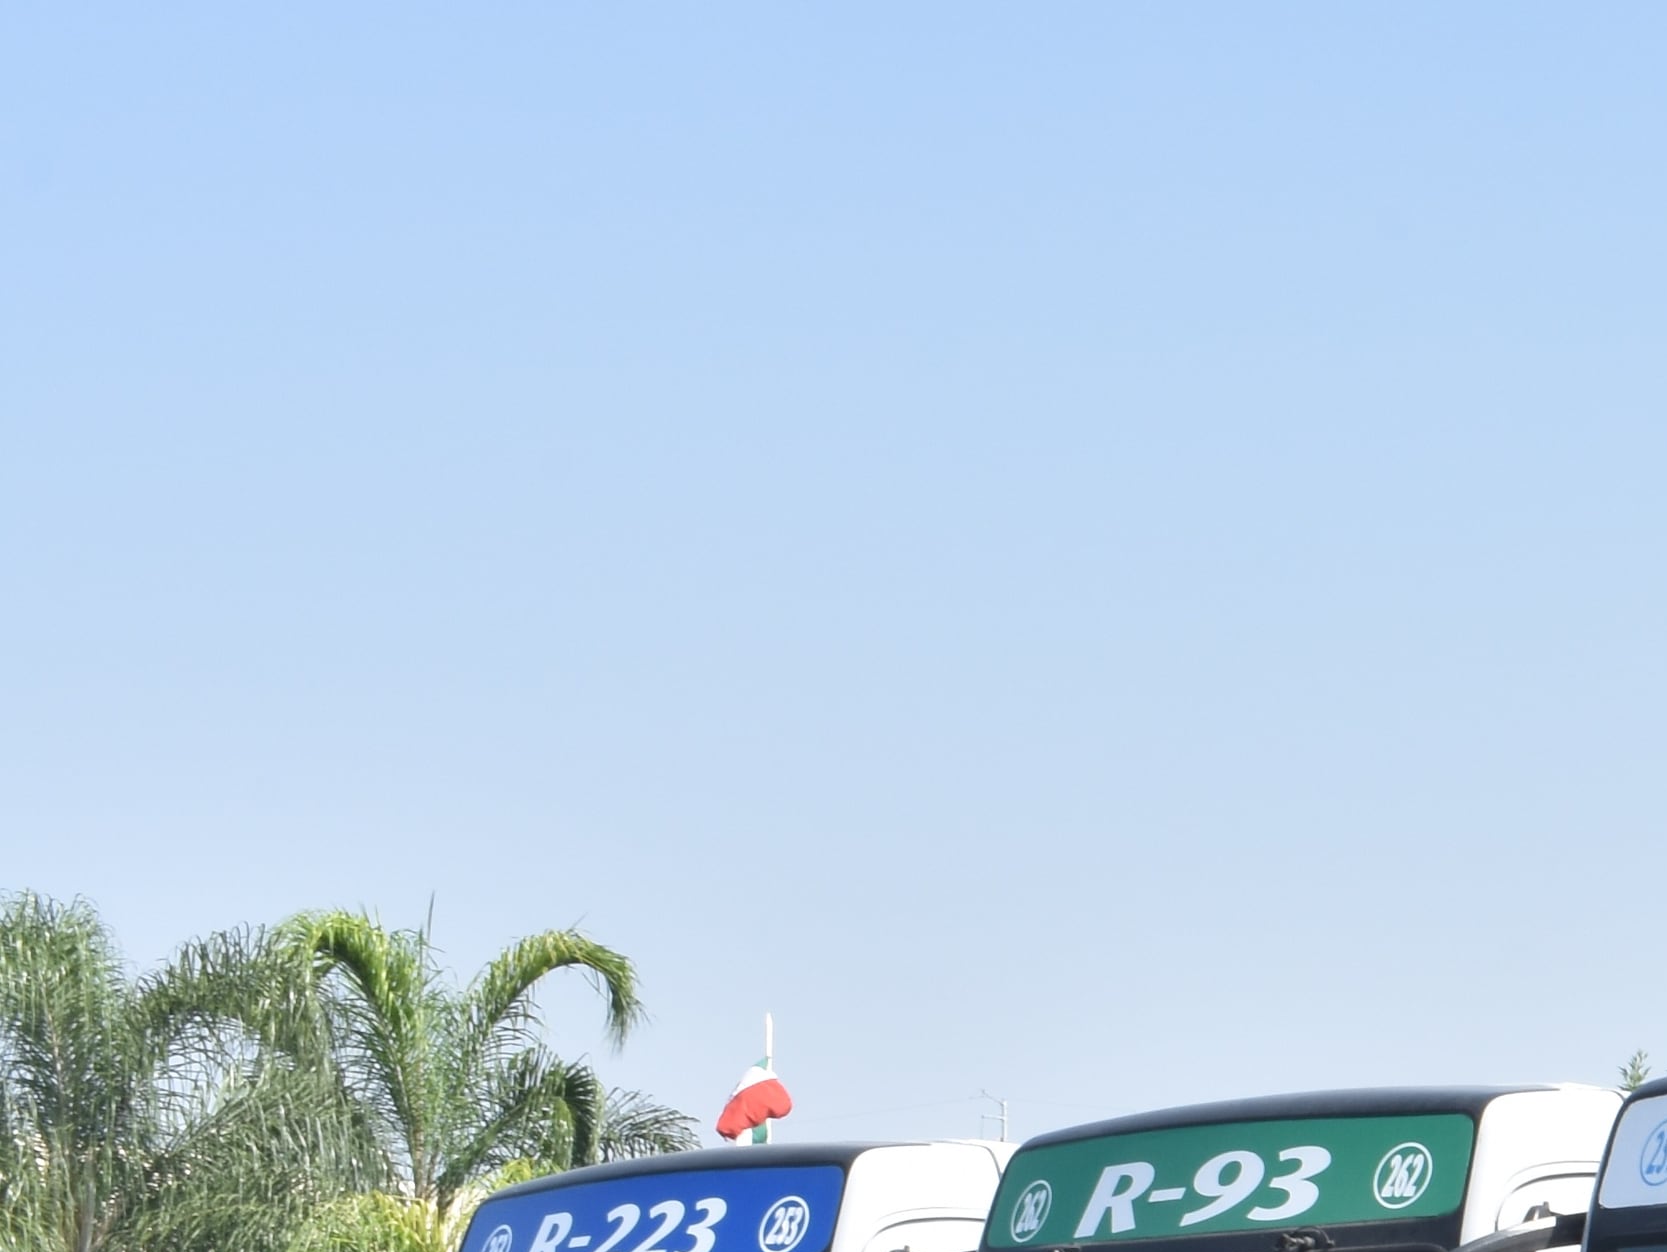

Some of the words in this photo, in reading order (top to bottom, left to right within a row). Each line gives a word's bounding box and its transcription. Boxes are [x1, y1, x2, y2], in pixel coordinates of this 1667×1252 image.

[1074, 1145, 1332, 1239] R-93
[1380, 1153, 1425, 1197] 262
[765, 1206, 803, 1245] 253
[1015, 1190, 1044, 1233] 262
